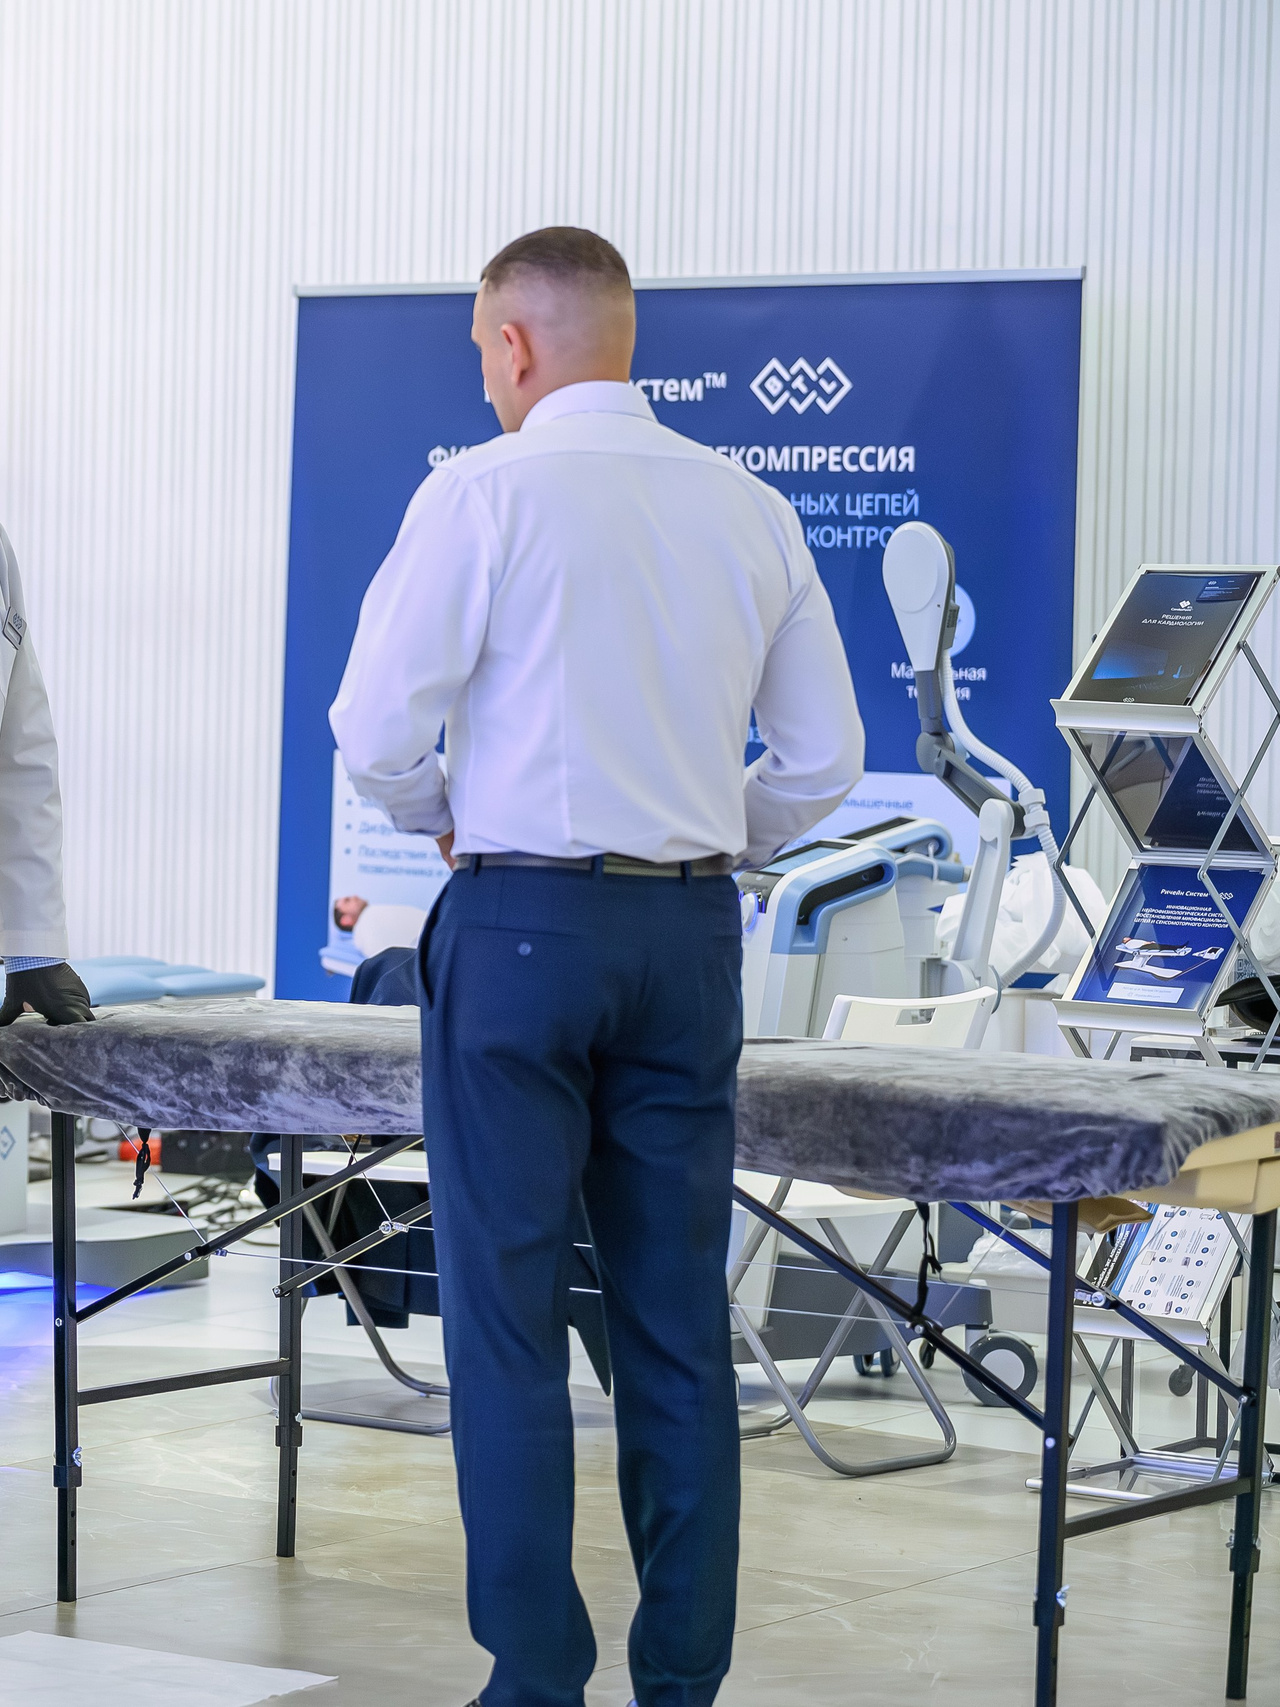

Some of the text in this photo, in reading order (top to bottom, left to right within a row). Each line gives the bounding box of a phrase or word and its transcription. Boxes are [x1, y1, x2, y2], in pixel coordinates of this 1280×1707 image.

[629, 371, 727, 402] стем™
[710, 445, 915, 473] КОМПРЕССИЯ
[790, 488, 919, 519] НЫХ ЦЕПЕЙ
[806, 524, 894, 549] КОНТРО
[1185, 890, 1209, 898] Систем
